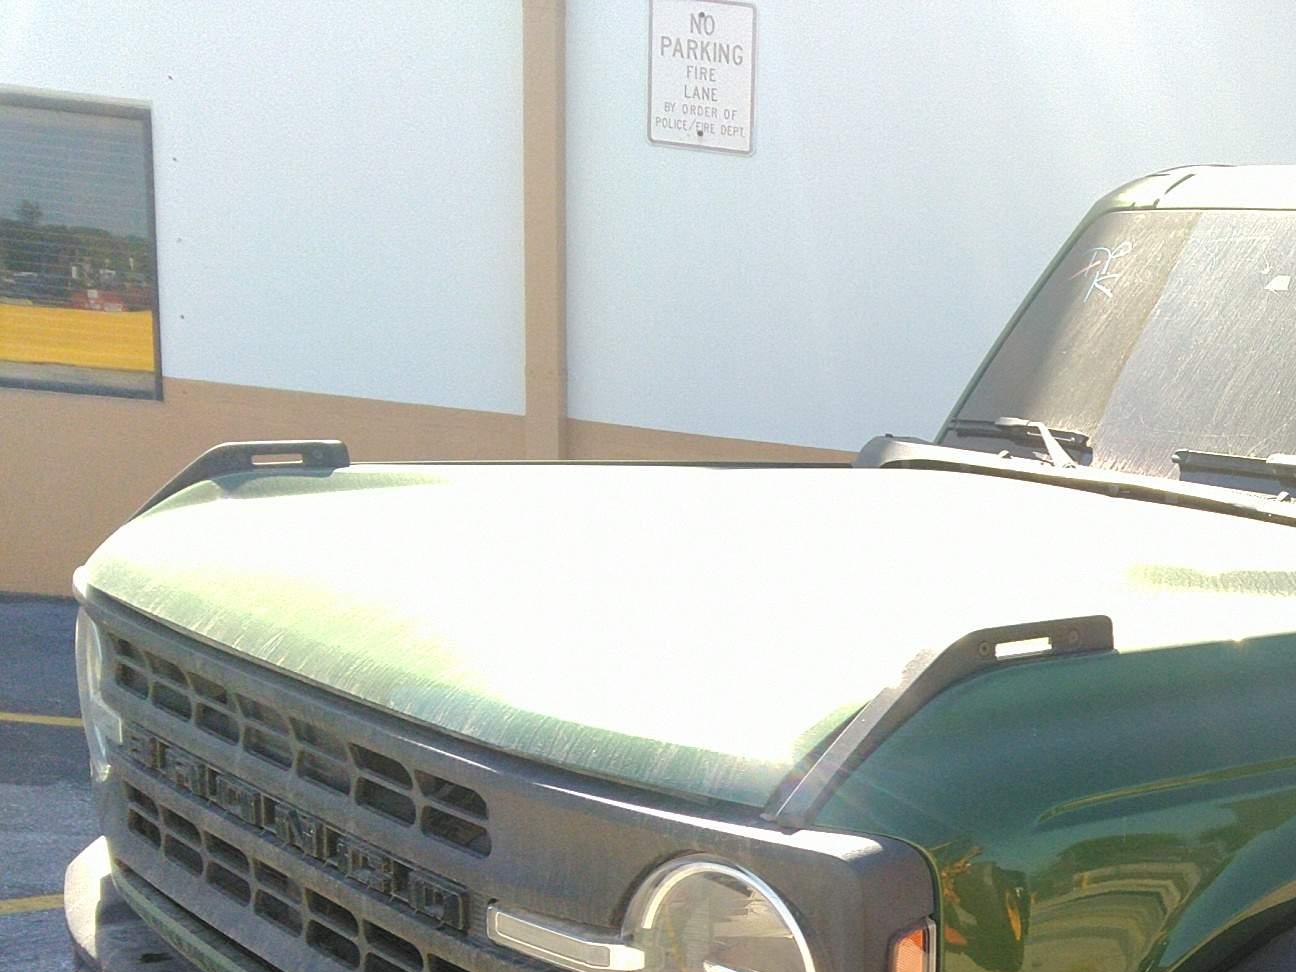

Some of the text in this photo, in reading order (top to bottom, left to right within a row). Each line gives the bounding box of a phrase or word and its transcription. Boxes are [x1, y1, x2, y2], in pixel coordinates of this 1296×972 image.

[690, 13, 716, 35] NO
[660, 36, 744, 65] PARKING
[686, 65, 717, 82] FIRE
[684, 85, 718, 102] LANE
[664, 102, 738, 121] BY ORDER OF
[655, 116, 715, 135] POLICE/FIRE
